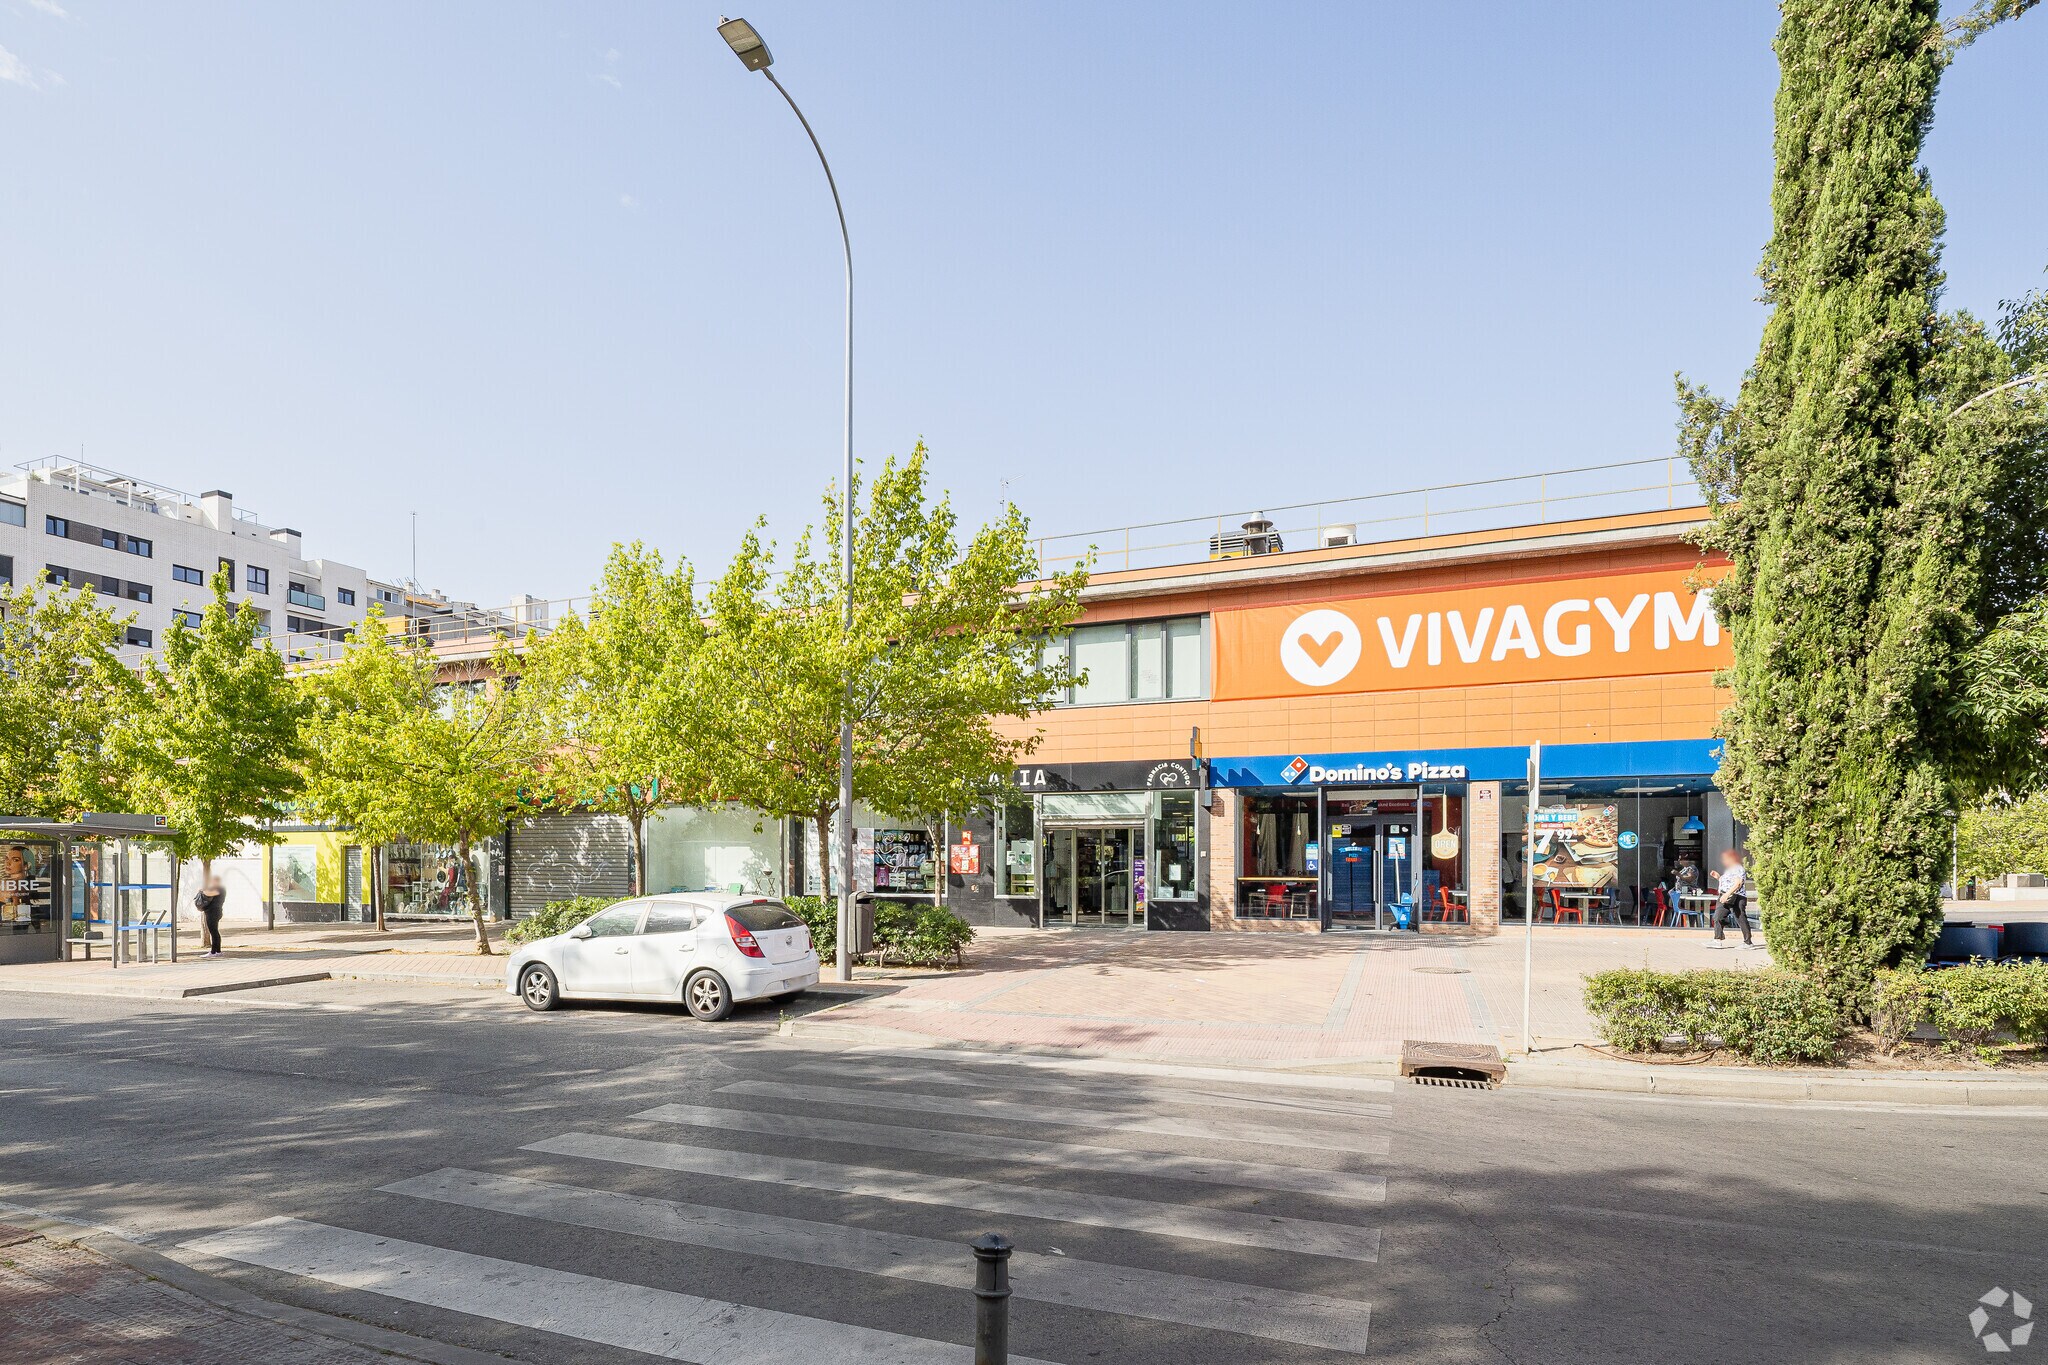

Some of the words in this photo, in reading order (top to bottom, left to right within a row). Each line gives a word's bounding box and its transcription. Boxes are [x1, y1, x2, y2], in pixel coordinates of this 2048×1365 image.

[1376, 588, 1719, 668] VIVAGYM
[1170, 762, 1191, 785] CONTIGO
[1309, 763, 1403, 782] Domino's
[1407, 761, 1466, 779] Pizza
[1435, 839, 1456, 849] OPEN
[1, 879, 39, 891] IBRE
